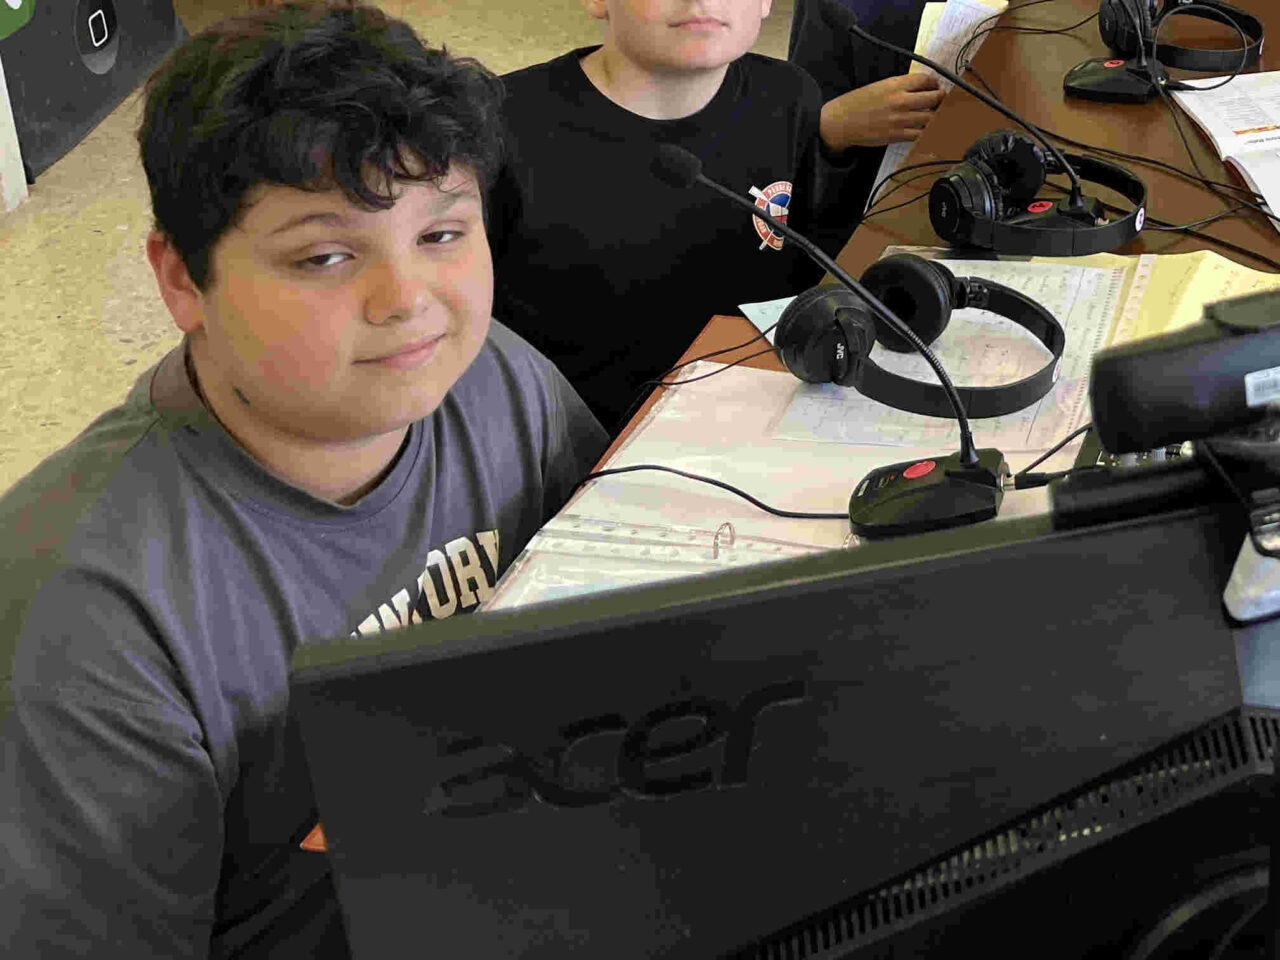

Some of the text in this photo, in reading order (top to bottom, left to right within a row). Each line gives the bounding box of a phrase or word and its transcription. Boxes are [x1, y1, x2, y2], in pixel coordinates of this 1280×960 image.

[836, 343, 844, 359] JVC
[417, 529, 499, 619] OR
[430, 678, 808, 817] acer
